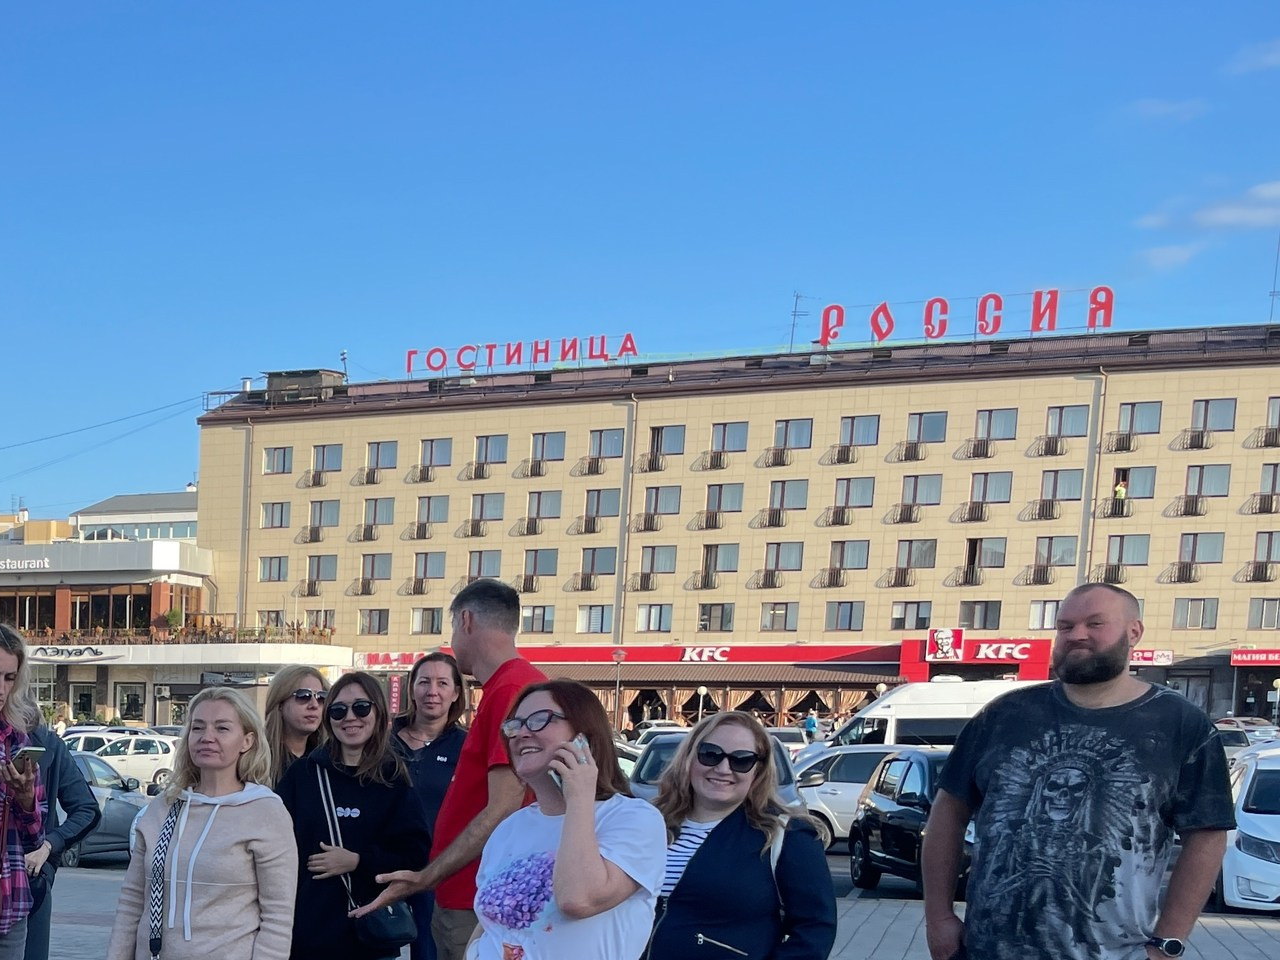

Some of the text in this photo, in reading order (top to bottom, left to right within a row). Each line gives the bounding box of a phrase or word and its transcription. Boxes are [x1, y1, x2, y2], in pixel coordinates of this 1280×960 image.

[820, 286, 1114, 346] РОССИЯ
[406, 333, 638, 373] ГОСТИНИЦА
[682, 647, 730, 662] KFC
[976, 643, 1031, 660] KFC
[1233, 653, 1267, 661] МАГИЯ
